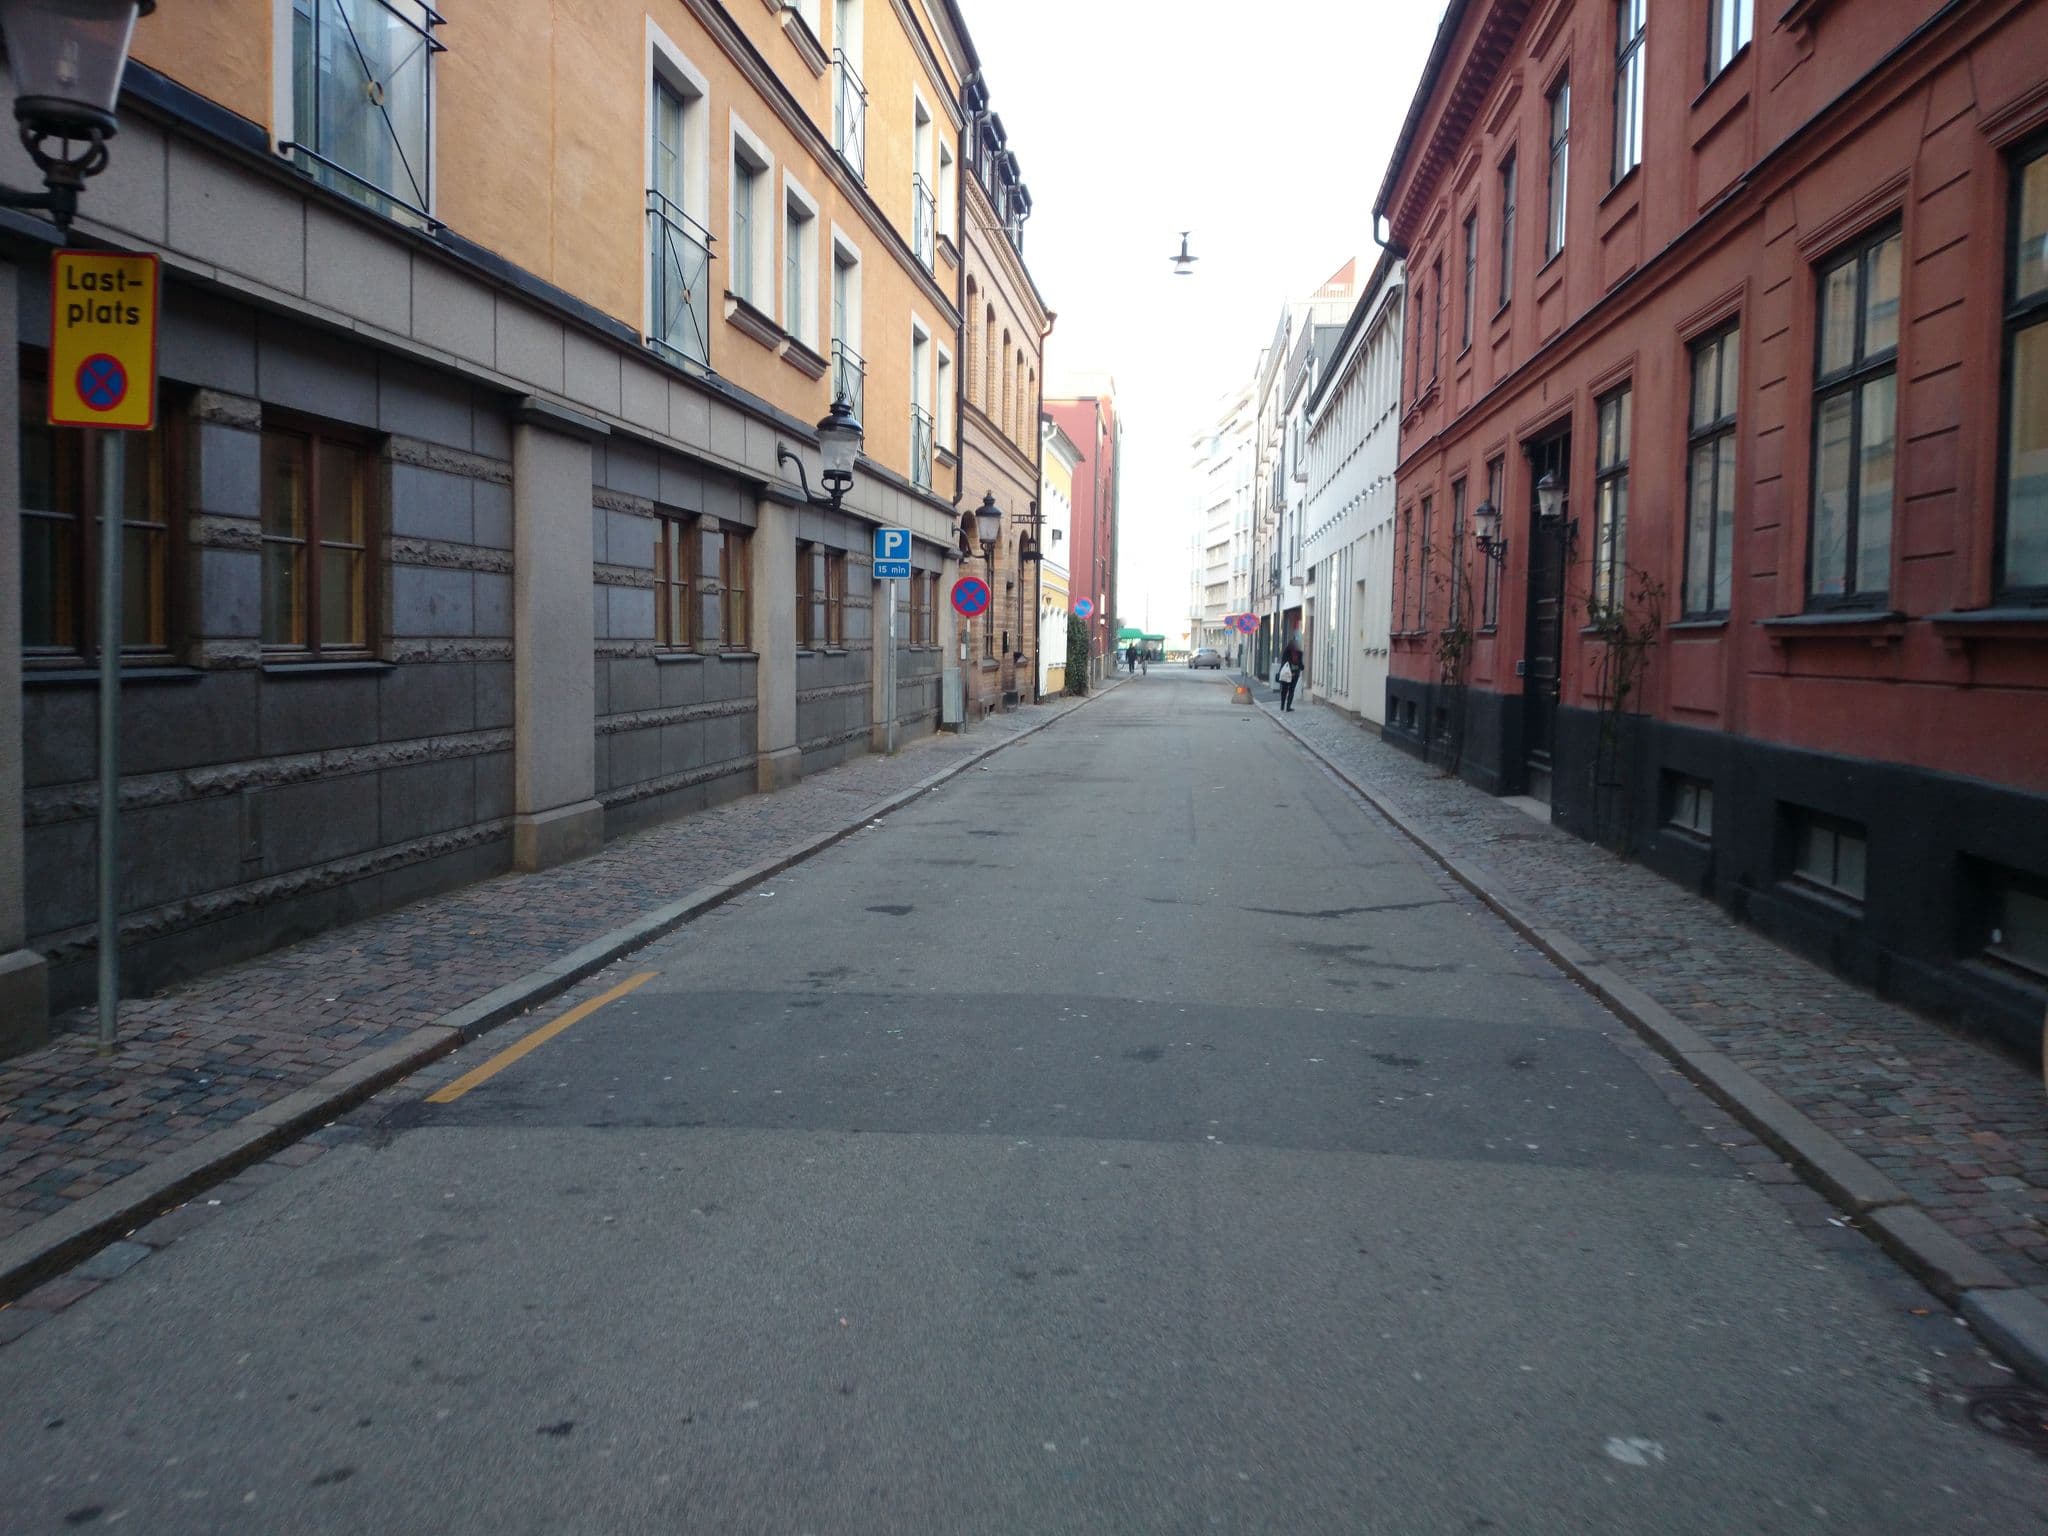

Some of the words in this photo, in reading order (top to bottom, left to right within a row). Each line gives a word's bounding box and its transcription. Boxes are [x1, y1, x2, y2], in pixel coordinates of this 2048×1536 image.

[67, 265, 144, 292] Last-
[67, 298, 140, 329] plats
[885, 531, 903, 557] P
[879, 565, 888, 574] 15
[891, 566, 906, 575] min
